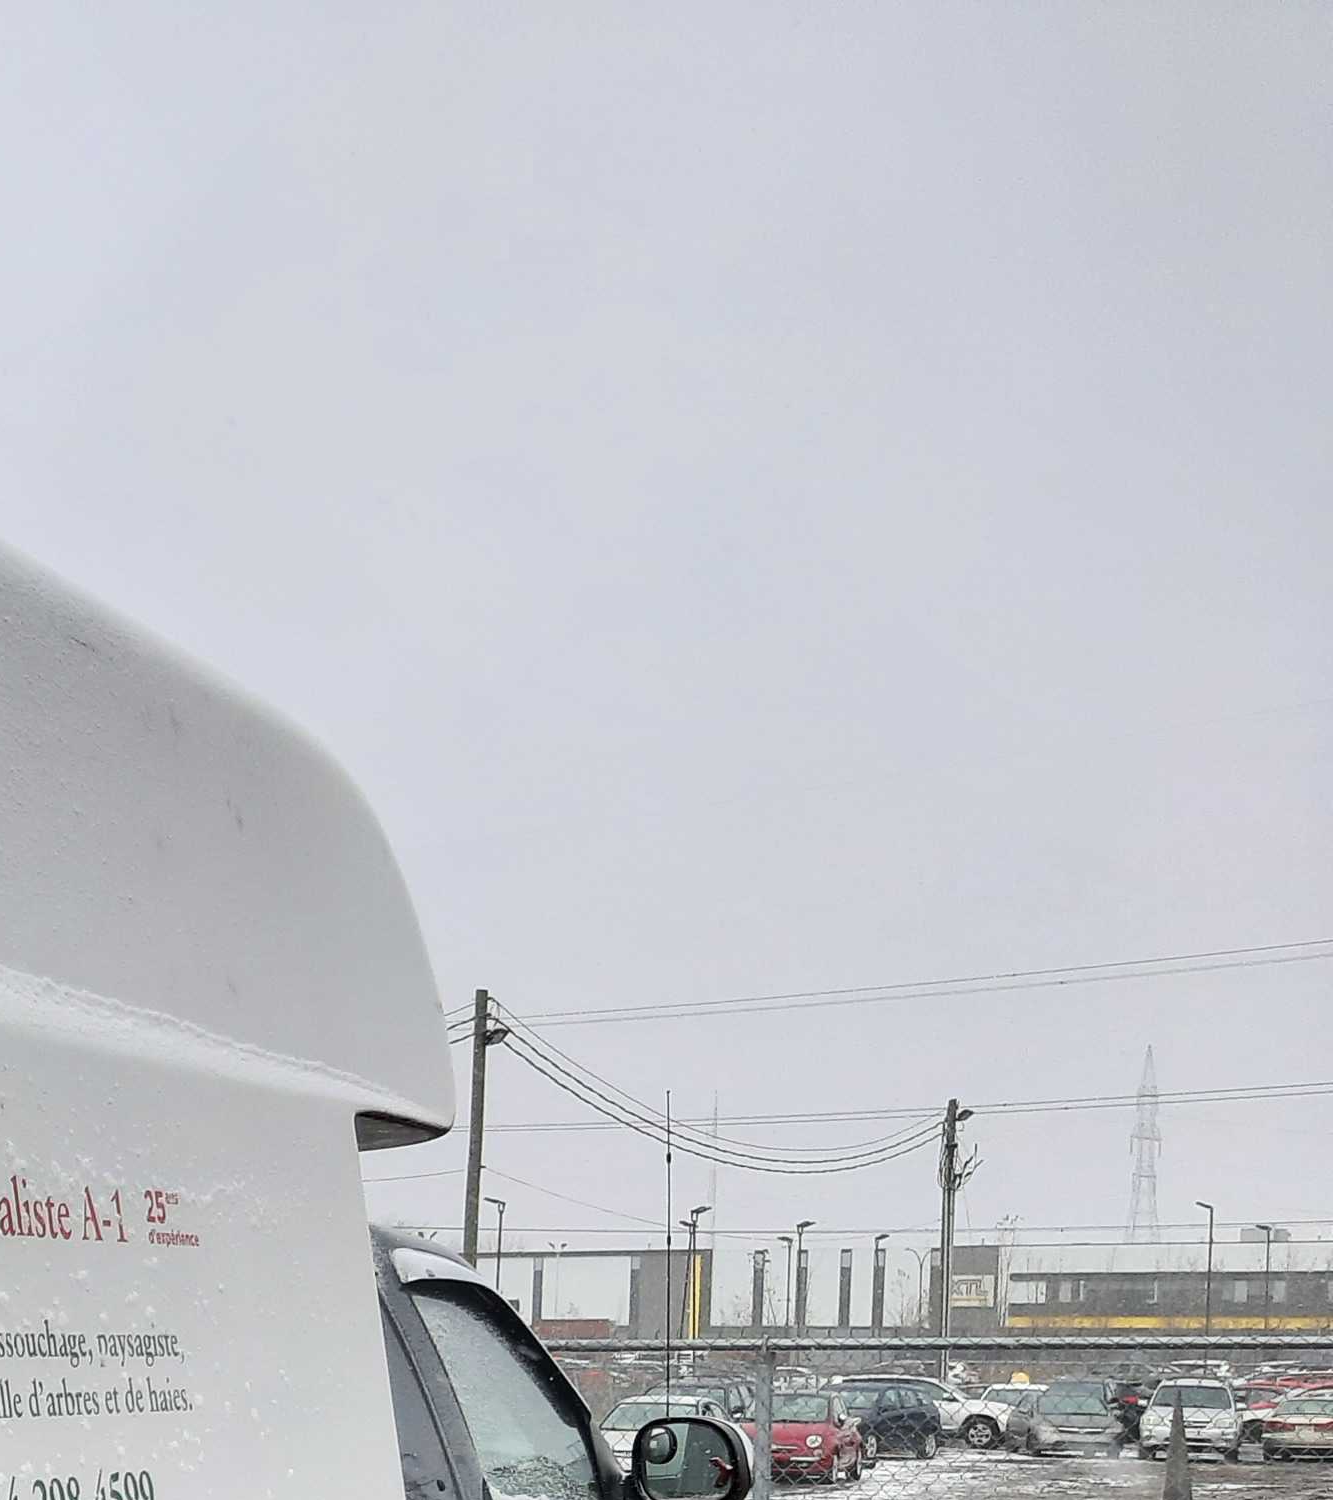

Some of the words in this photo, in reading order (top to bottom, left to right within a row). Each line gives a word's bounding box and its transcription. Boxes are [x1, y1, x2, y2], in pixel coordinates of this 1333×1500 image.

[81, 1186, 129, 1243] A-1
[143, 1190, 166, 1224] 25
[29, 1378, 101, 1418] d'arbres
[104, 1386, 121, 1415] et
[124, 1377, 145, 1413] de
[146, 1376, 194, 1413] haies.
